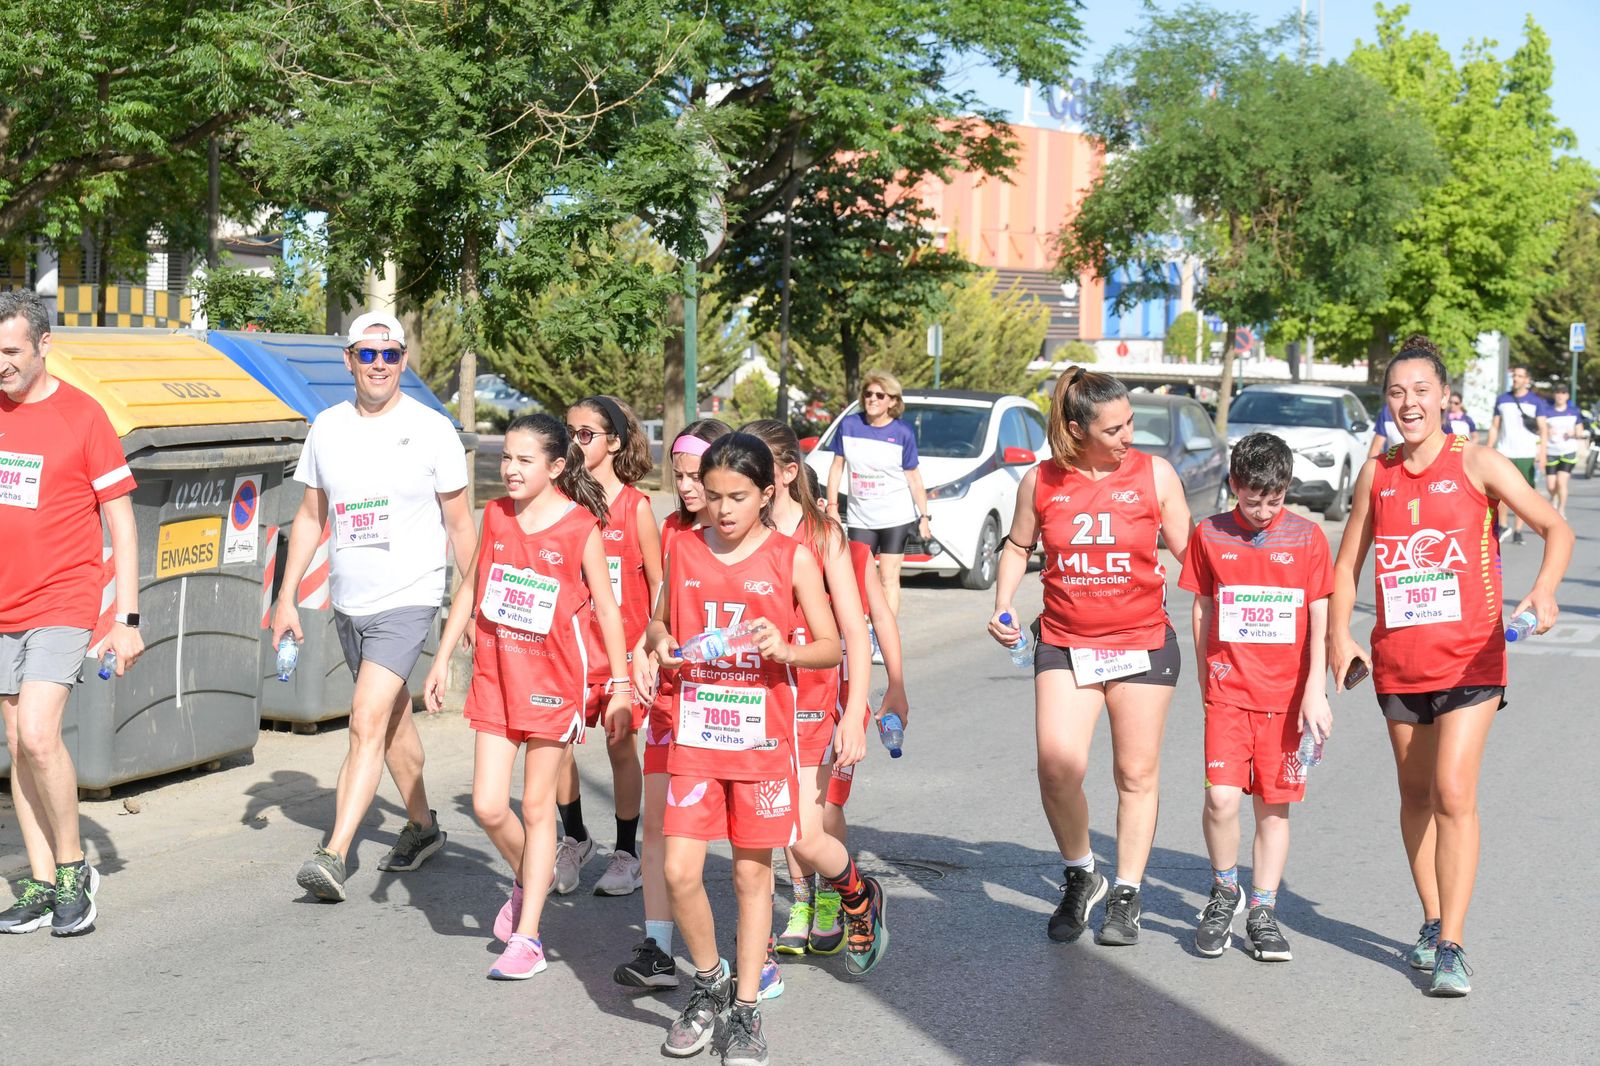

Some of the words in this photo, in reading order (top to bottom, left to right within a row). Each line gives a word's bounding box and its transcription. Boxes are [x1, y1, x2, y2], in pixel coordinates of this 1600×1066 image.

[162, 383, 222, 398] 0203
[0, 457, 41, 469] OVIRAN
[1428, 480, 1459, 494] RACA
[175, 480, 226, 510] 0203
[1111, 491, 1139, 503] RACA
[345, 499, 388, 511] COVIRAN
[1407, 498, 1420, 525] 1
[350, 513, 375, 527] 7657
[1070, 512, 1116, 545] 21
[1221, 552, 1238, 560] vive
[1375, 528, 1468, 570] RACA
[161, 543, 214, 570] ENVASES
[1058, 552, 1131, 575] MLG
[1270, 552, 1294, 564] RACA
[502, 573, 558, 593] COVIRAN
[685, 578, 701, 588] vive
[1397, 572, 1454, 585] COVIRAN
[744, 581, 774, 595] RACA
[503, 588, 536, 609] 7654
[1235, 594, 1293, 602] COVIRAN
[1405, 587, 1437, 604] 7567
[507, 613, 533, 624] vithas
[704, 601, 747, 632] 17
[1241, 608, 1274, 622] 7523
[1416, 609, 1442, 618] vithas
[1250, 629, 1277, 637] vithas
[1106, 663, 1133, 673] vithas
[1209, 661, 1231, 680] 77
[697, 691, 762, 704] COVIRAN
[704, 707, 741, 727] 7805
[714, 733, 745, 744] vithas
